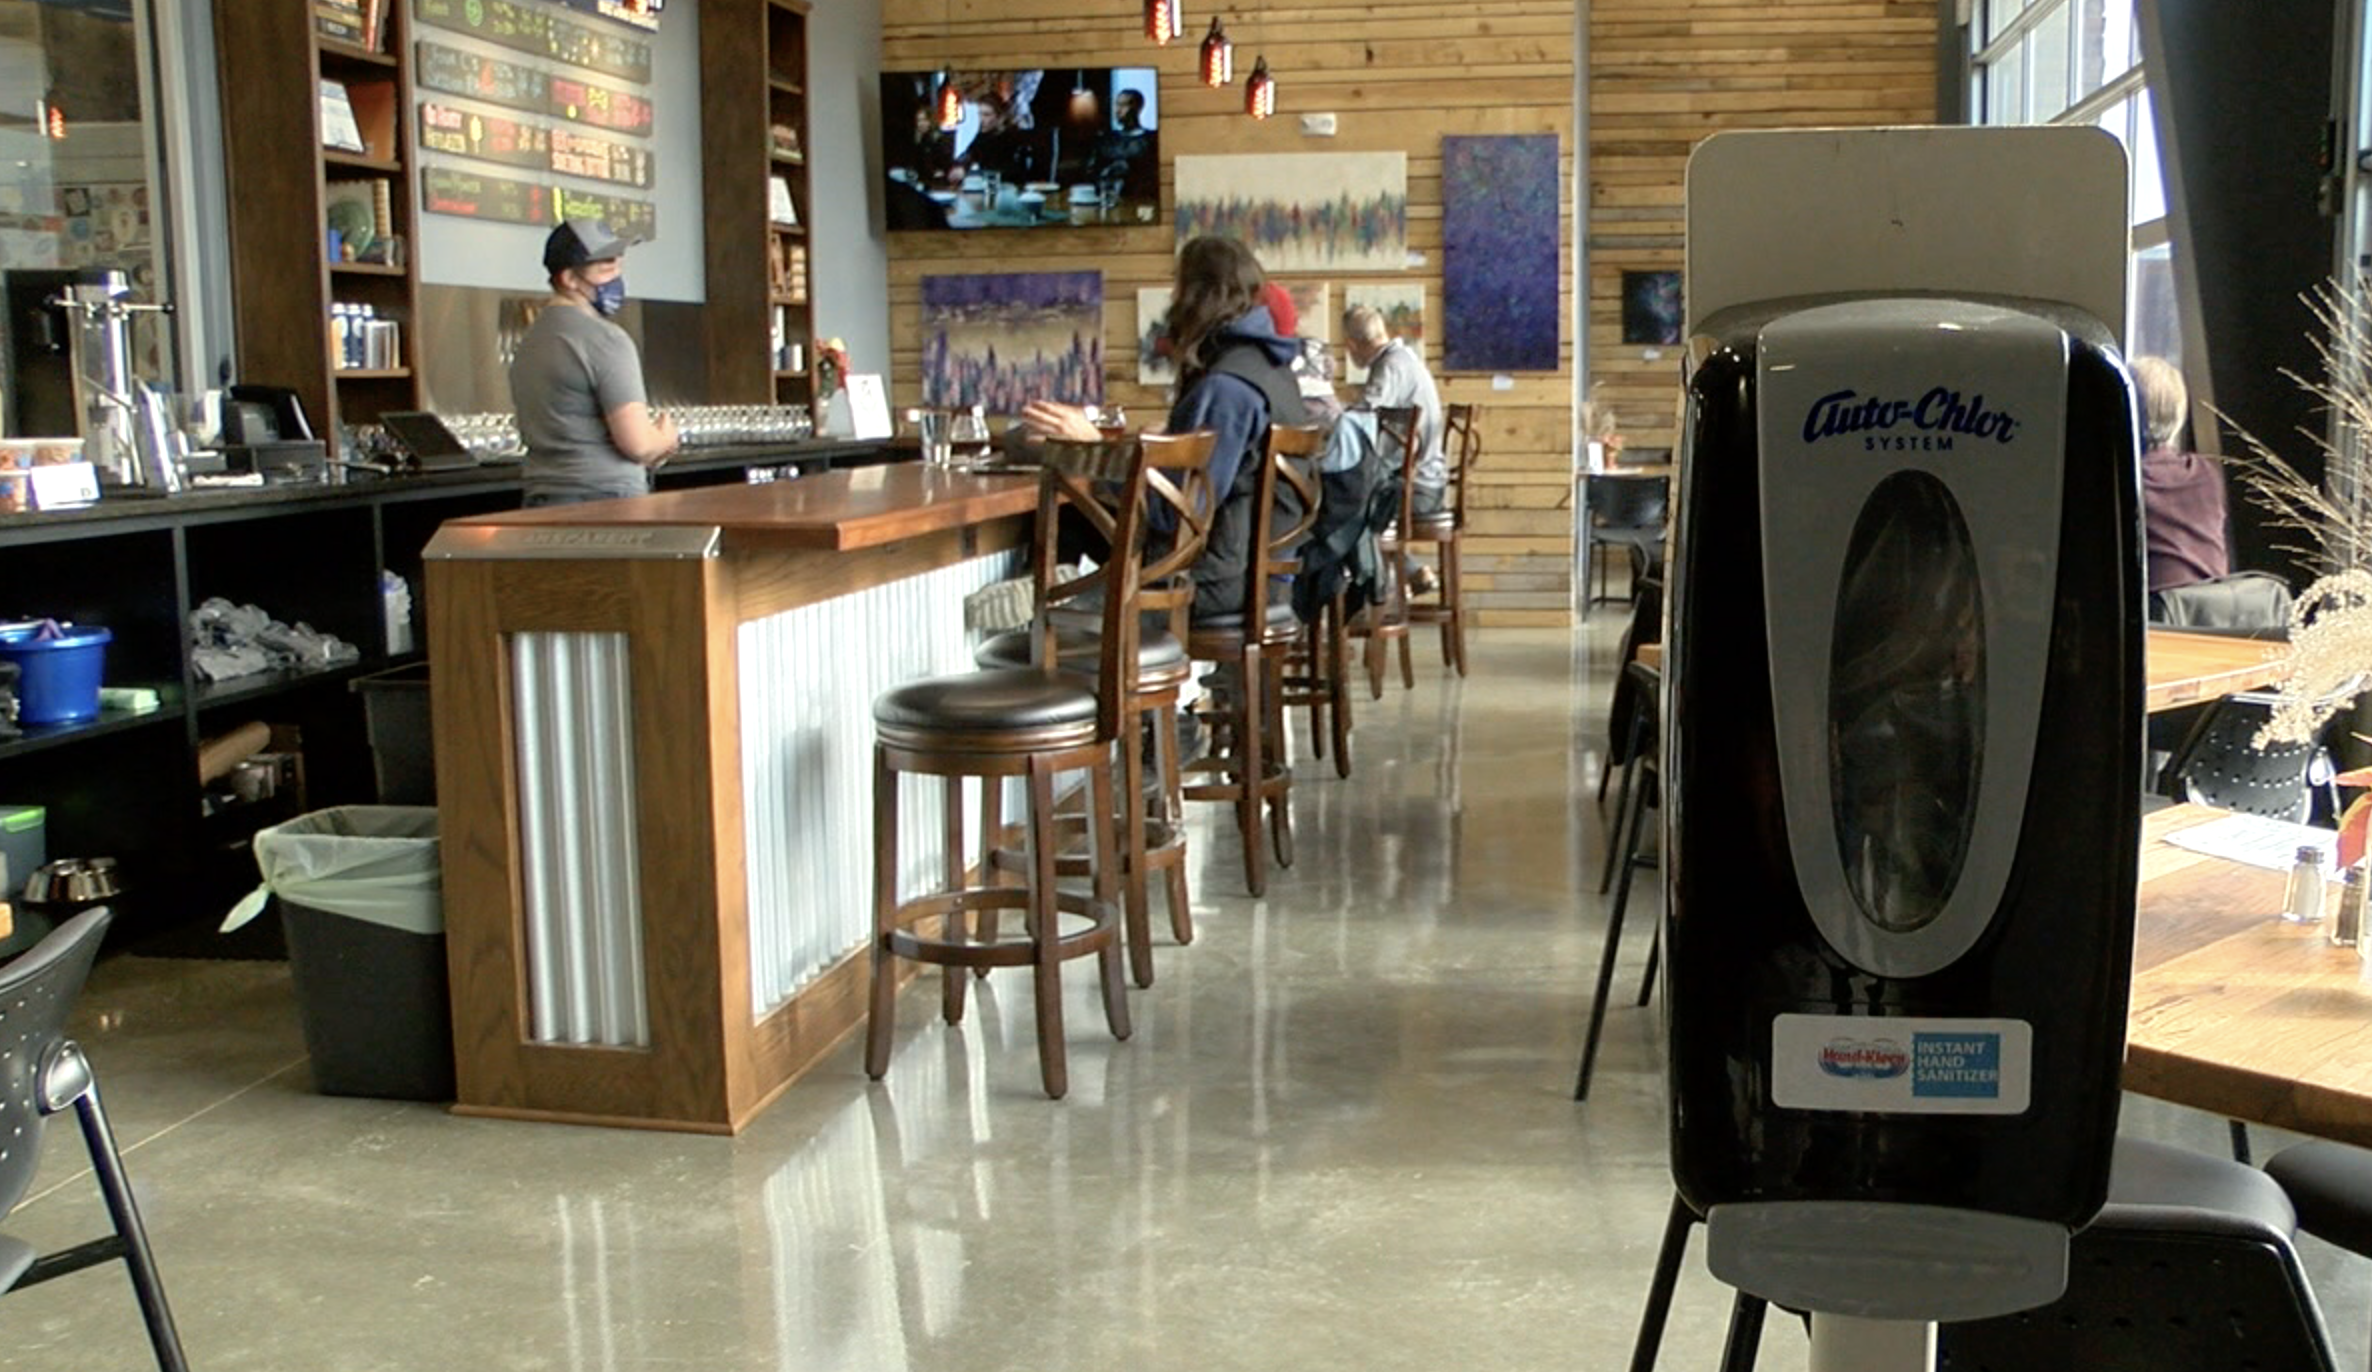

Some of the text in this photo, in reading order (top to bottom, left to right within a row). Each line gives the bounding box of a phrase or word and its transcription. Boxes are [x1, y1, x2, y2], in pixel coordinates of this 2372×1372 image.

[1803, 387, 2015, 443] Auto-Chlor
[1864, 436, 1954, 451] SYSTEM
[1917, 1041, 1985, 1055] INSTANT
[1917, 1056, 1965, 1068] HAND
[1916, 1069, 1999, 1083] SANITIZER
